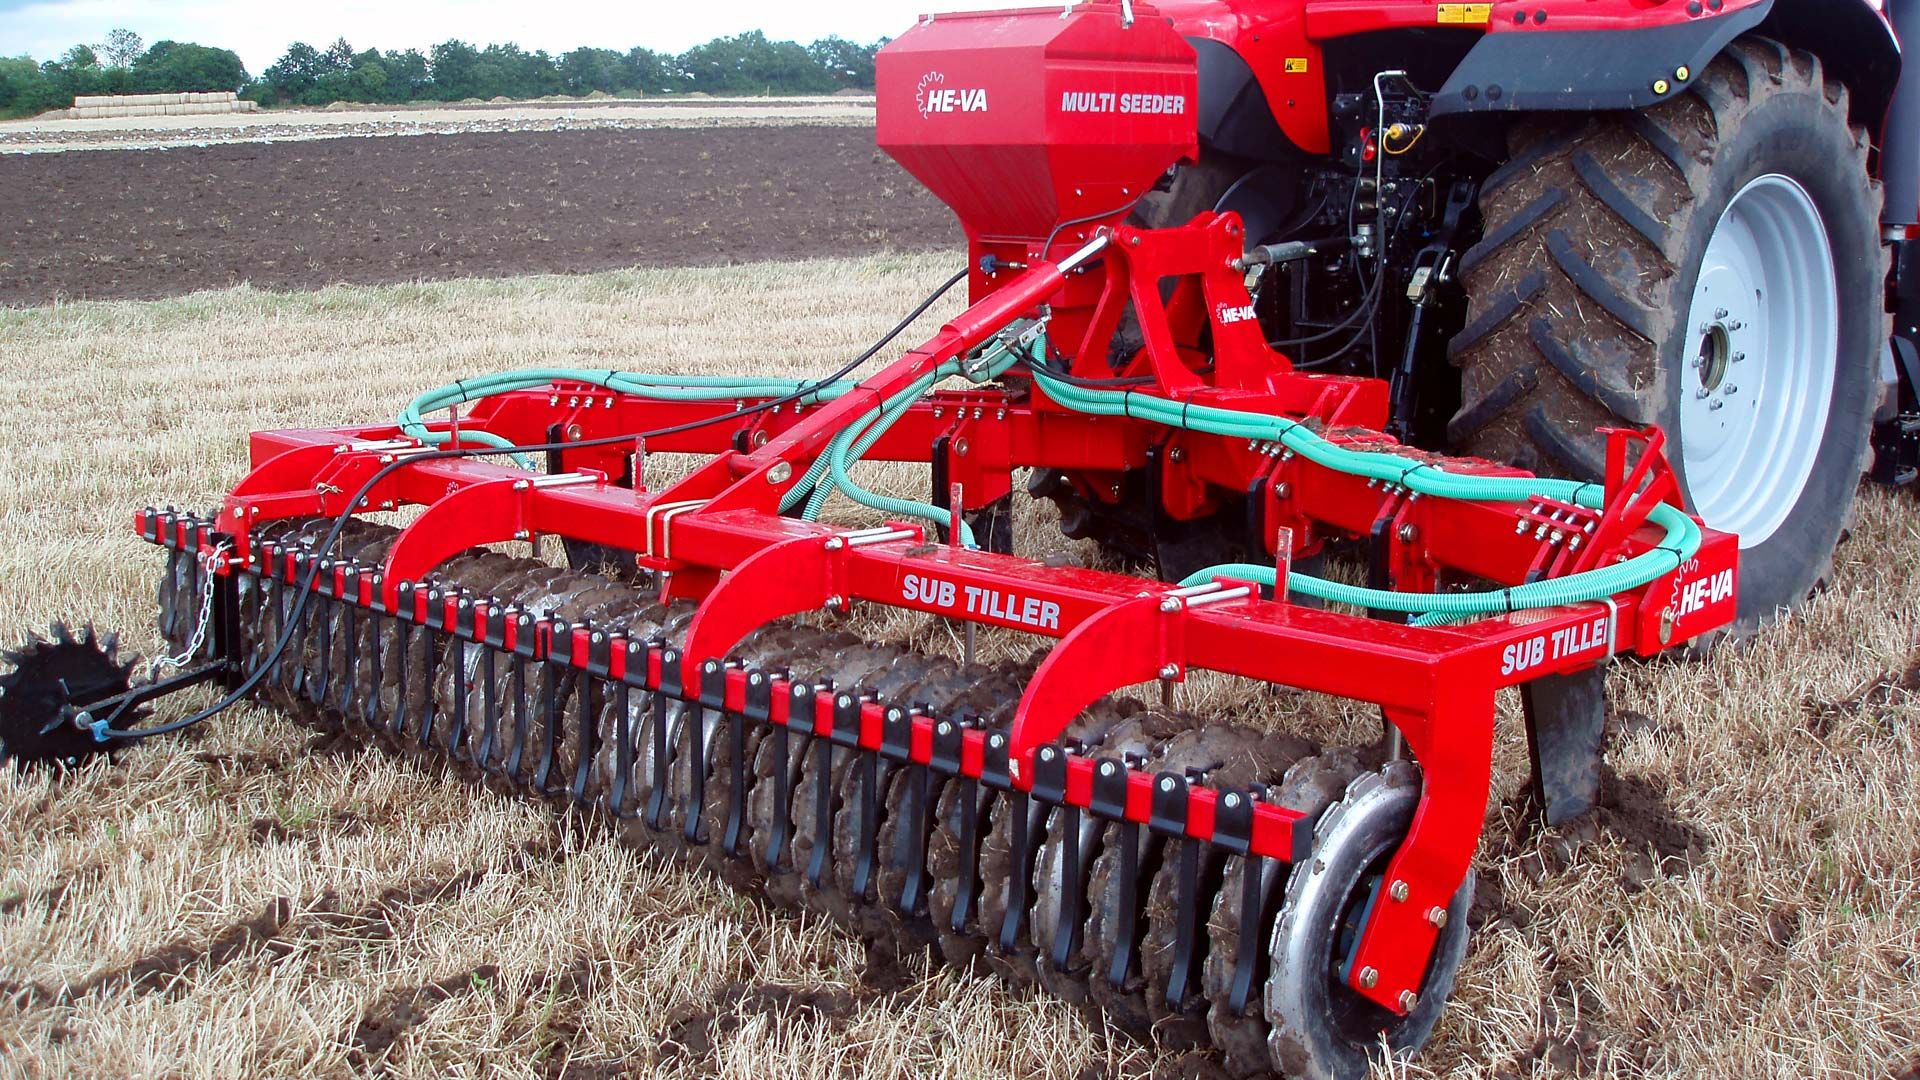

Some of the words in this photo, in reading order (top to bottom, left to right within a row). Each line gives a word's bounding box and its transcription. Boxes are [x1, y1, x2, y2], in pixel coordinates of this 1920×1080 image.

[926, 88, 989, 113] HE-VA
[1061, 91, 1116, 113] MULTI
[1118, 93, 1185, 115] SEEDER
[1221, 305, 1257, 323] HE-VA
[902, 574, 957, 607] SUB
[964, 585, 1061, 630] TILLER
[1679, 568, 1734, 616] HE-VA
[1501, 635, 1546, 676] SUB
